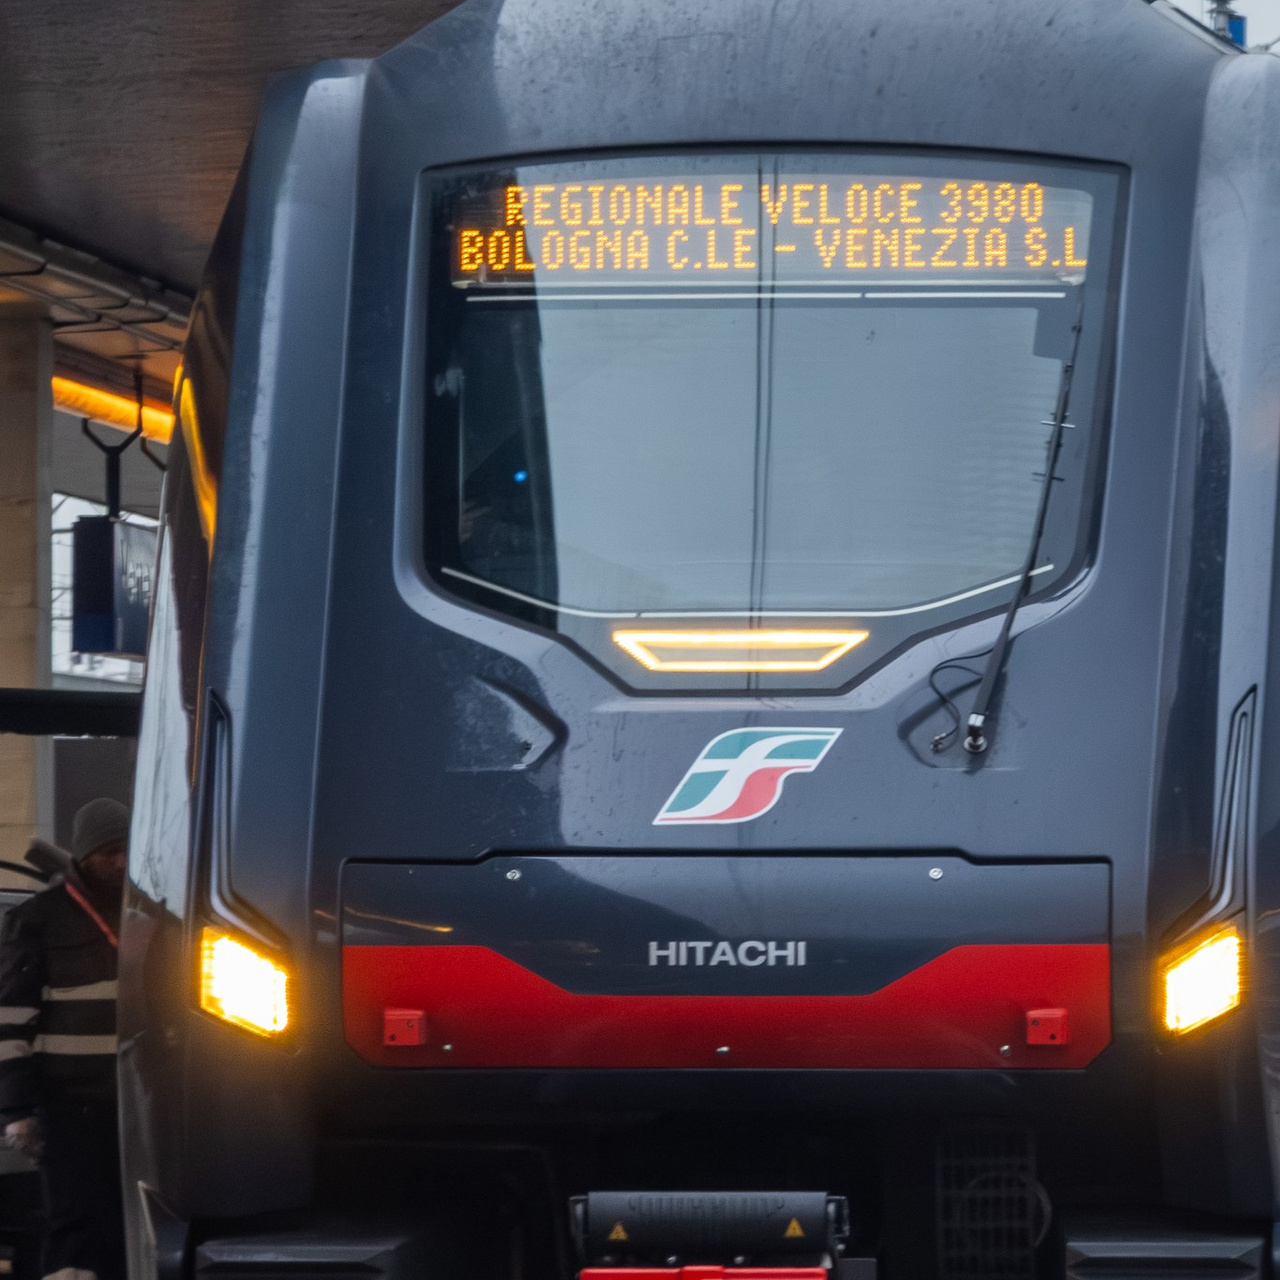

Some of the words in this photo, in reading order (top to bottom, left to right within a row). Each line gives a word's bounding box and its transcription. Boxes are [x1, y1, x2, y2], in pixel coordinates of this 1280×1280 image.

[505, 184, 743, 225] REGIONALE
[761, 183, 922, 224] VELOCE
[940, 182, 1044, 223] 3980
[460, 229, 649, 270] BOLOGNA
[666, 228, 757, 270] C.LE
[813, 227, 1007, 268] VENEZIA
[1025, 226, 1087, 268] S.L
[648, 941, 807, 966] HITACHI
